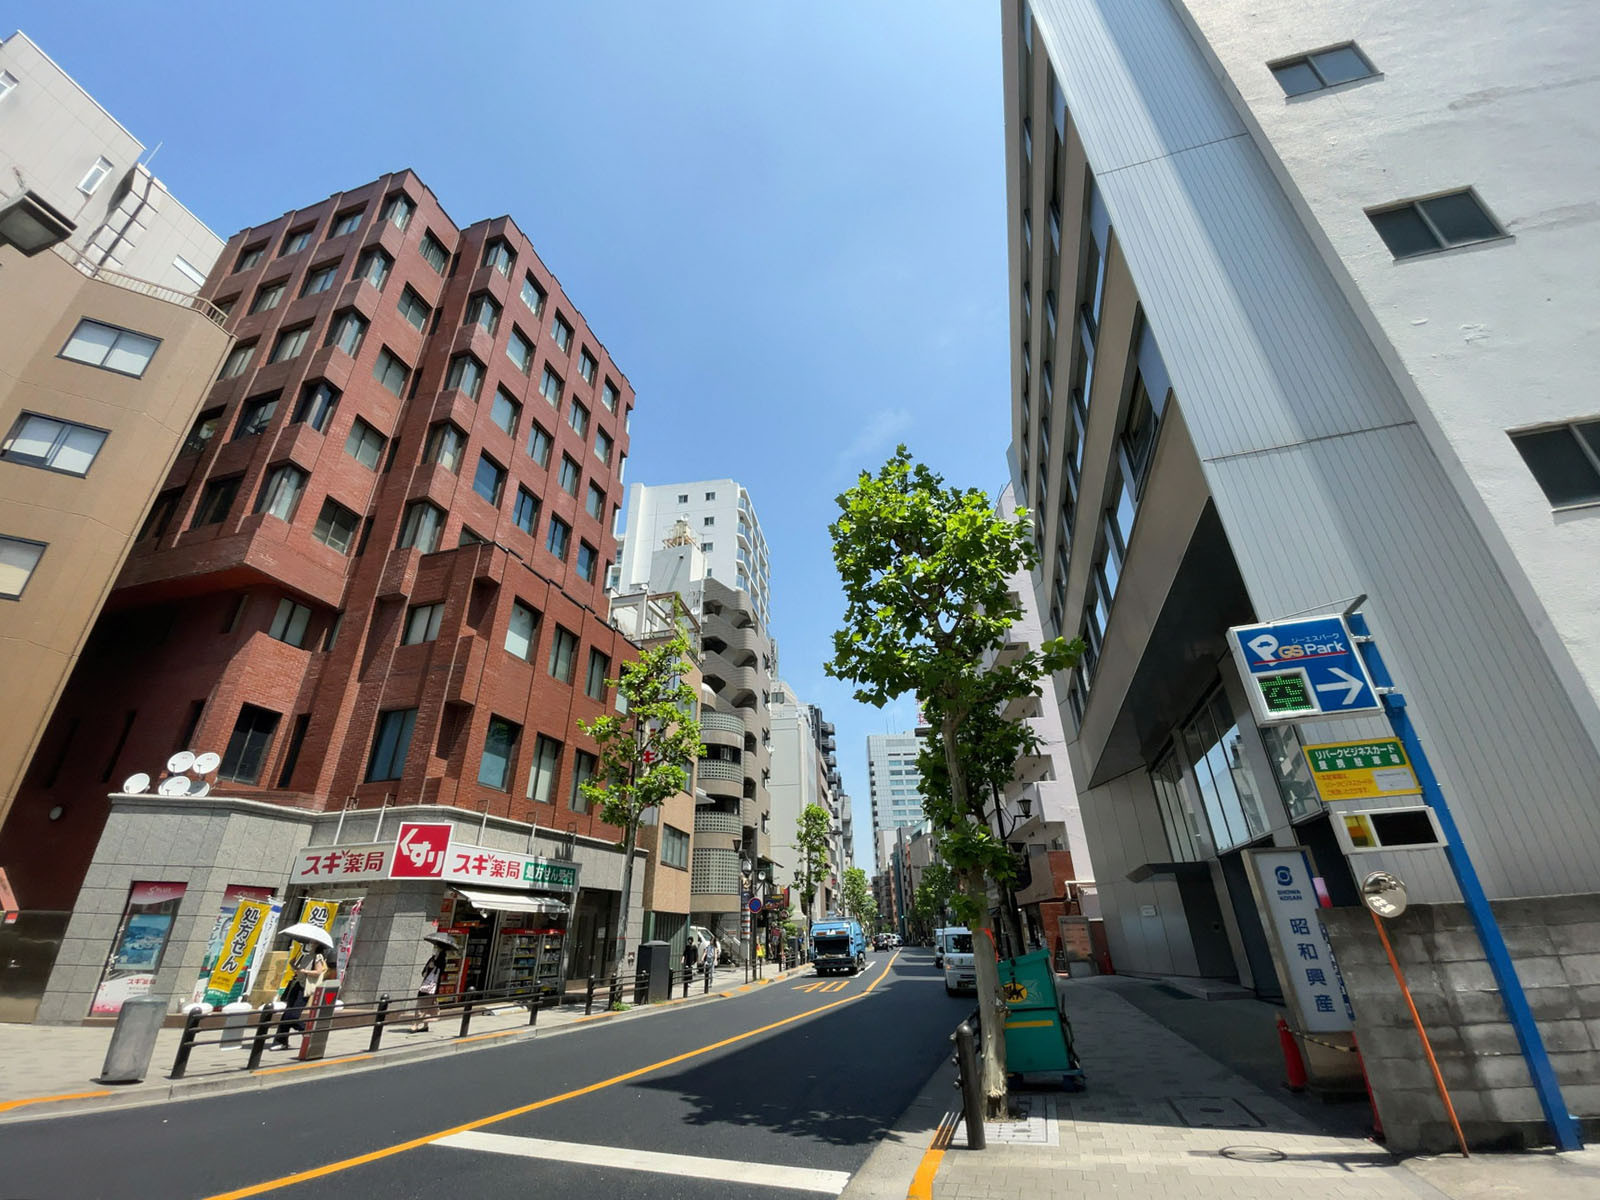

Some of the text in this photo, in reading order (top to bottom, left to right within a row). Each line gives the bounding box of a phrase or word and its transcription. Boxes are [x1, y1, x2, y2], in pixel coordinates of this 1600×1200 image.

[1259, 676, 1313, 712] 空
[1315, 744, 1396, 760] リパークビジネスカード
[301, 850, 385, 876] スギ薬局
[400, 828, 445, 874] くすり
[453, 853, 521, 880] スギ薬局
[221, 907, 260, 973] 処方せん
[1290, 918, 1336, 1013] 昭和興産
